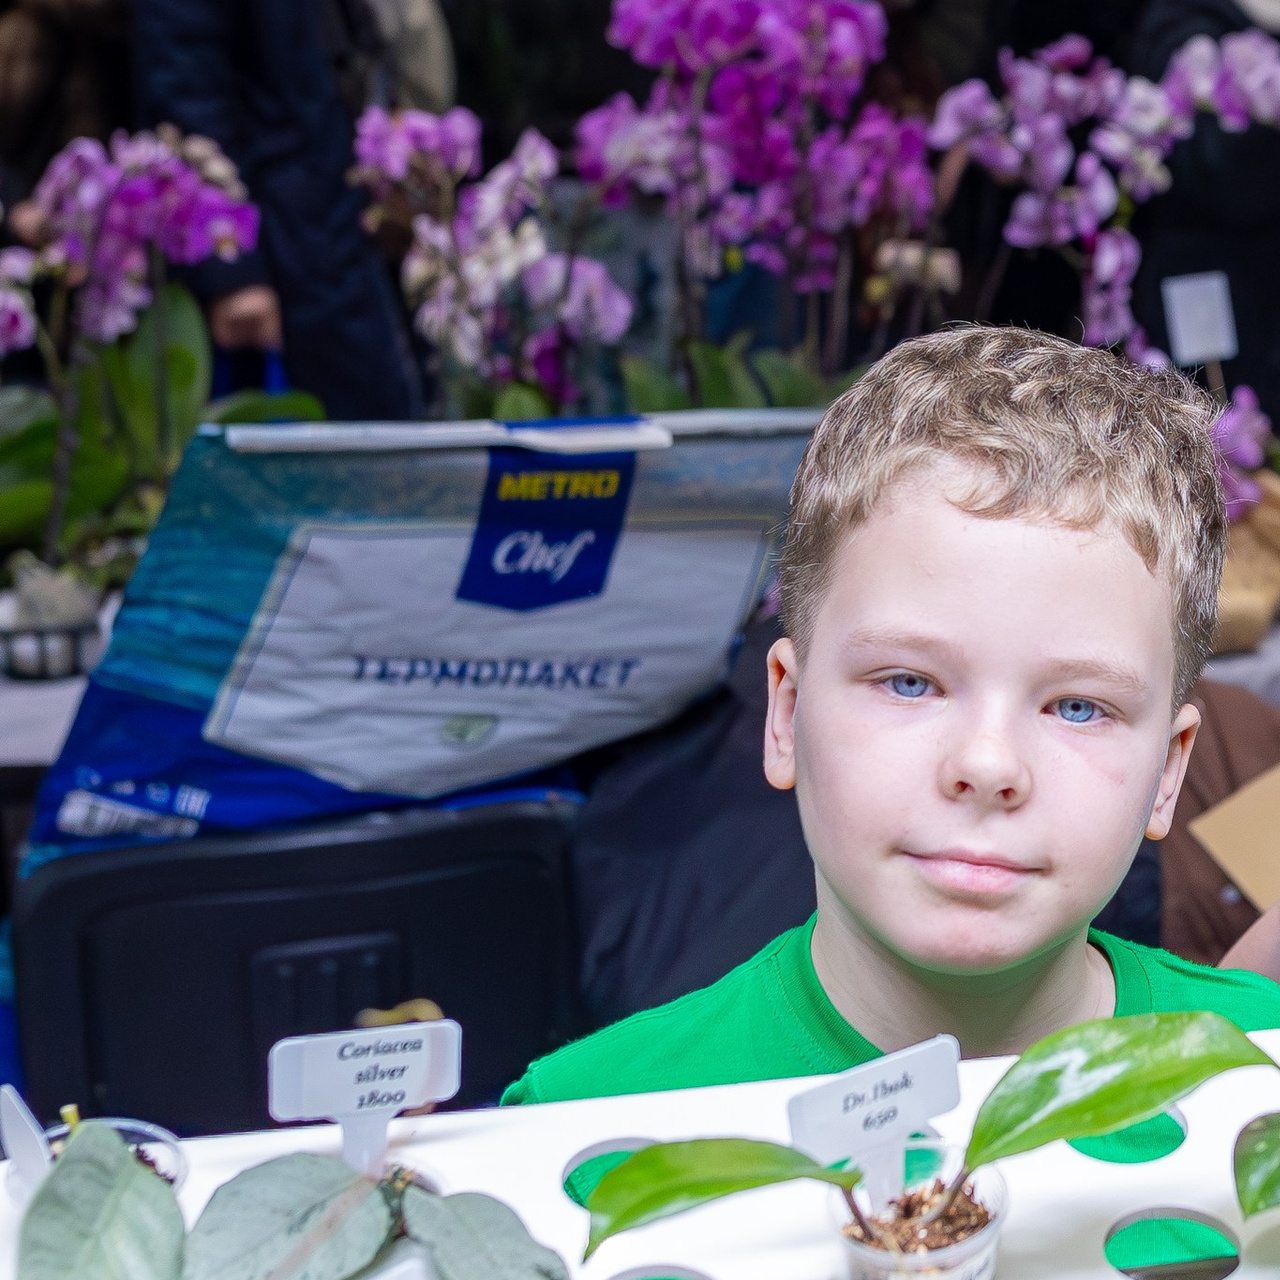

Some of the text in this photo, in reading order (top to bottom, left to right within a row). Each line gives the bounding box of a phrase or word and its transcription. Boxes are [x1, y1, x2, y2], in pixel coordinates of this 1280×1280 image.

[497, 470, 620, 500] METRO
[492, 529, 596, 584] Chef
[352, 654, 640, 690] ТЕРМОПАКЕТ
[337, 1037, 424, 1061] Coriacea
[354, 1063, 409, 1085] silver
[357, 1089, 406, 1109] 1800
